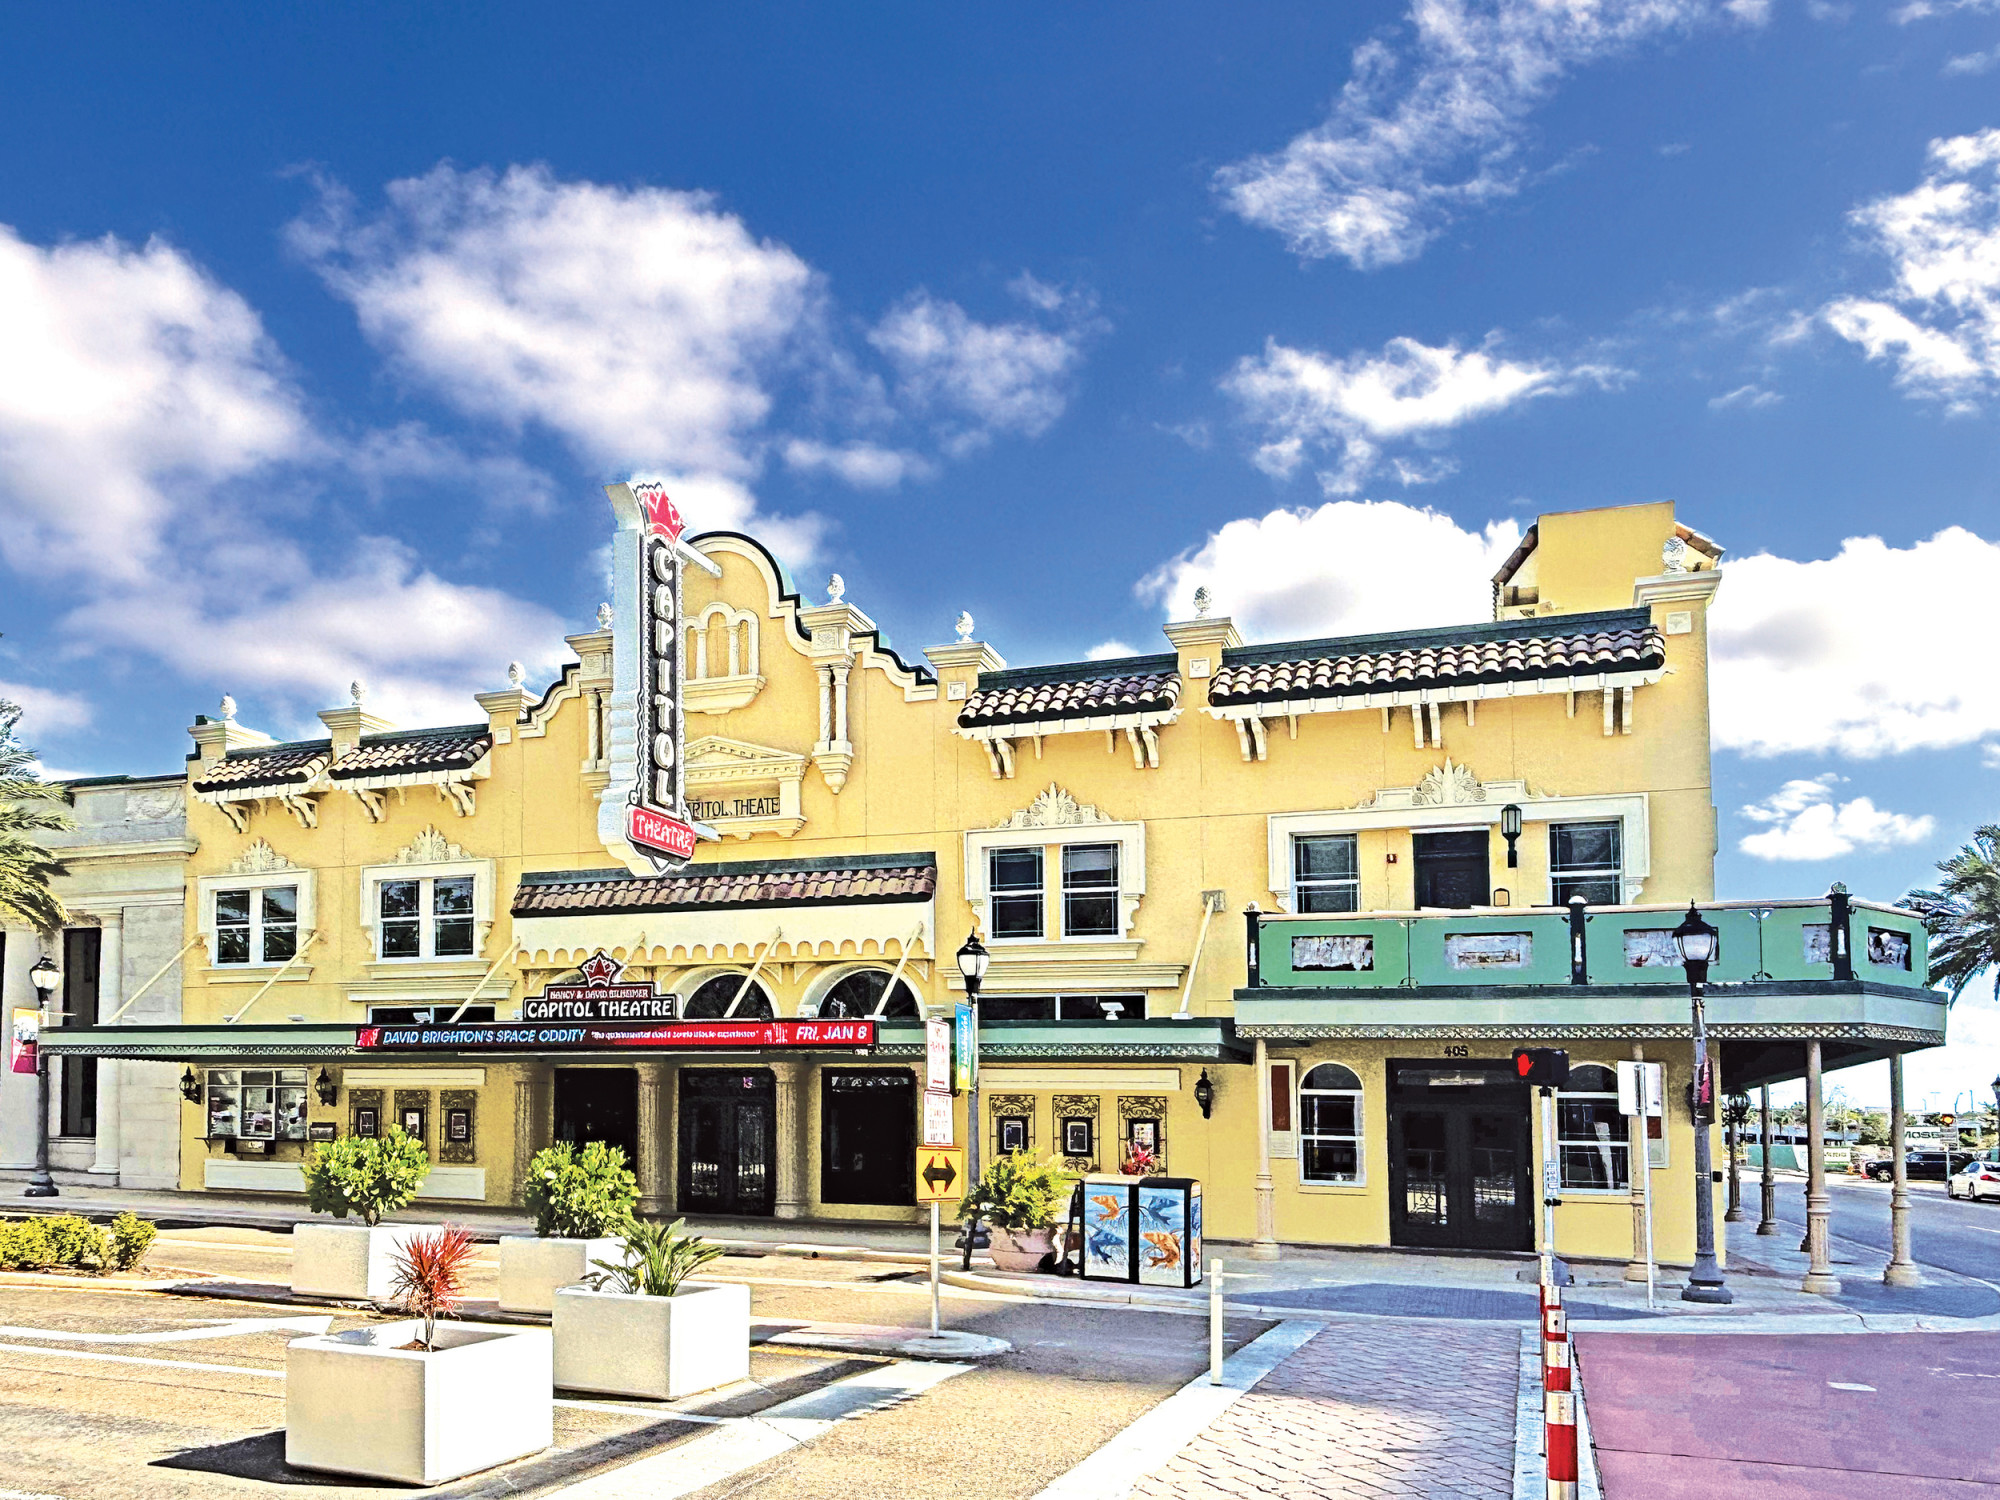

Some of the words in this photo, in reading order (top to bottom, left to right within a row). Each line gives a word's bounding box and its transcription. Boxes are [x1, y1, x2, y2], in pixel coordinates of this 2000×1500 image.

[653, 546, 675, 806] CAPITOL
[687, 800, 729, 818] PITOL
[636, 815, 693, 851] THEATRE
[550, 990, 575, 1000] NANCY
[576, 990, 584, 1000] &
[585, 989, 608, 999] DAVID
[527, 1002, 594, 1018] CAPITOL
[598, 1000, 672, 1017] THEATRE
[383, 1031, 419, 1045] DAVID
[421, 1030, 494, 1044] BRIGHTON'S
[496, 1029, 536, 1043] SPACE
[538, 1029, 587, 1043] ODDITY
[823, 1025, 854, 1040] JAN
[857, 1025, 868, 1040] 8
[1443, 1045, 1469, 1057] 405
